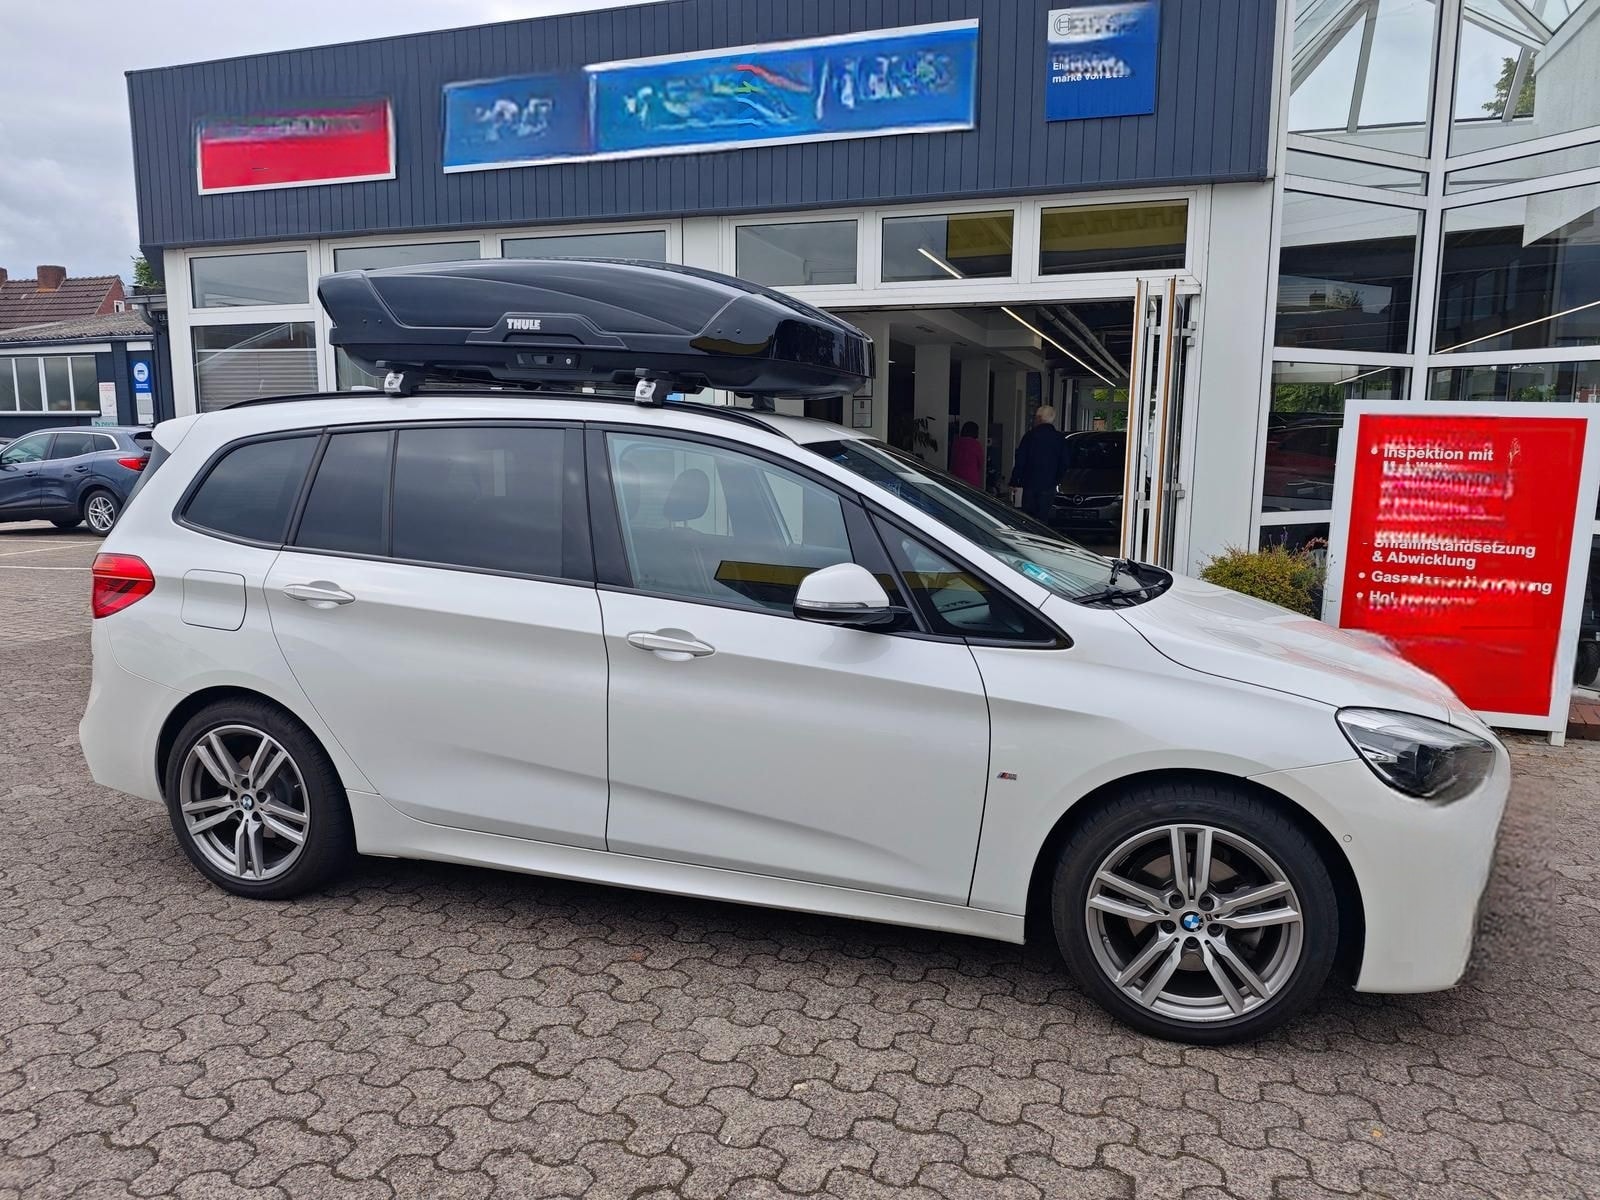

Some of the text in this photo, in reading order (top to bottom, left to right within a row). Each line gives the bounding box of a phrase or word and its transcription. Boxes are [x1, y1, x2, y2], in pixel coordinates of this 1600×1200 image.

[507, 318, 541, 330] THULE
[1384, 444, 1494, 461] Inspektion mit
[1372, 550, 1476, 570] & Abwicklung
